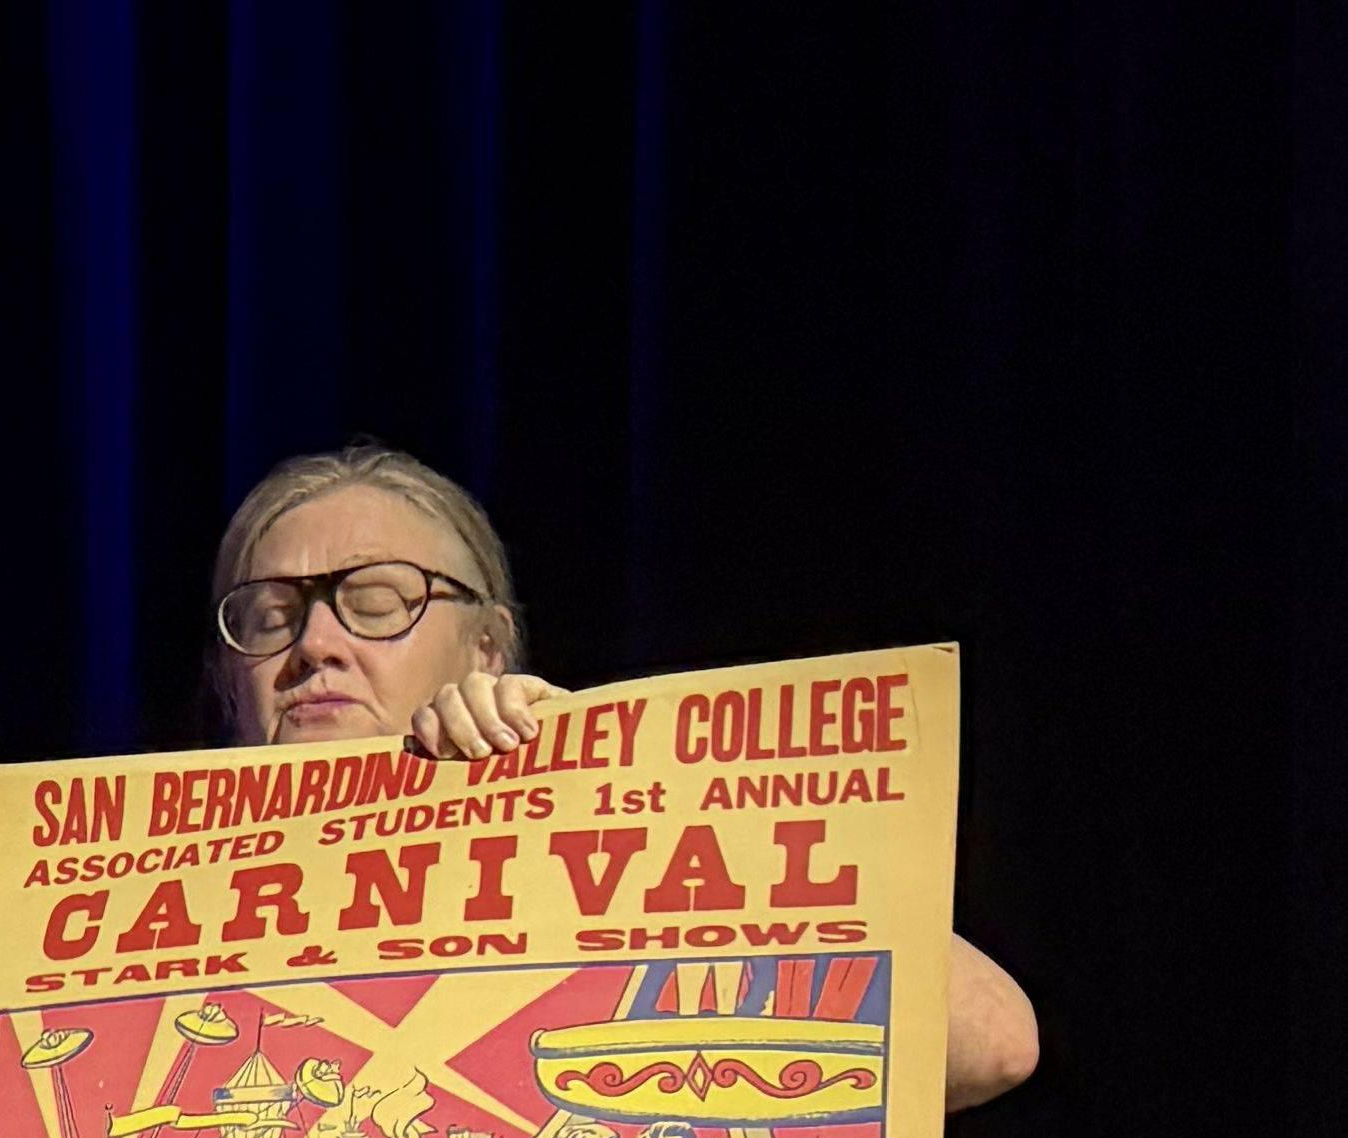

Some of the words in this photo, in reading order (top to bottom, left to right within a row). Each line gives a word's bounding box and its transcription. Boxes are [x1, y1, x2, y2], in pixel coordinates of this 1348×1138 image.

[32, 775, 126, 848] SAN
[147, 751, 438, 838] BERNARDINO
[675, 673, 909, 765] COLLEGE
[23, 830, 286, 888] ASSOCIATED
[318, 786, 555, 846] STUDENTS
[594, 782, 667, 817] 1st
[700, 767, 905, 811] ANNUAL
[42, 818, 859, 962] CARNIVAL
[25, 951, 250, 994] STARK
[286, 945, 338, 968] &
[377, 933, 528, 961] SON
[575, 920, 869, 952] SHOWS
